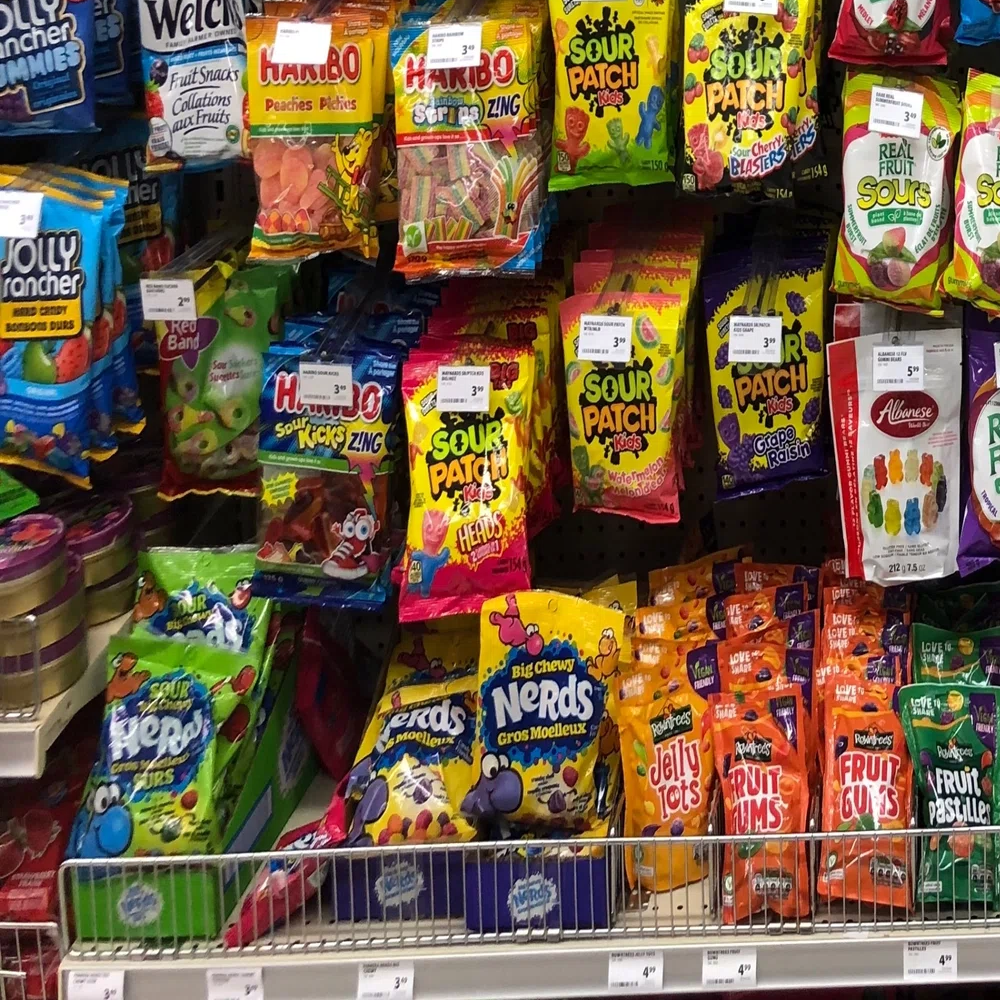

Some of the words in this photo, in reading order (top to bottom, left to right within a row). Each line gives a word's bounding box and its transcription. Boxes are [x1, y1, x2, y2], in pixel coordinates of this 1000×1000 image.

[569, 33, 634, 64] SOUR
[710, 49, 781, 79] SOUR
[170, 69, 199, 91] Fruit
[199, 66, 239, 82] Snacks
[568, 61, 638, 95] PATCH
[172, 94, 232, 117] Collations
[597, 91, 624, 106] Kids
[707, 79, 785, 115] PATCH
[172, 115, 195, 134] aux
[196, 109, 231, 127] Fruits
[736, 112, 766, 129] Kids
[751, 136, 784, 155] Cherry
[879, 142, 914, 160] REAL
[729, 147, 786, 178] BLASTERS
[878, 160, 914, 177] FRUIT
[857, 176, 932, 210] Sours
[4, 235, 77, 275] JOLLY
[3, 272, 80, 297] rancher
[13, 306, 37, 317] HARD
[5, 322, 47, 332] BONBONS
[49, 320, 75, 331] DURS
[171, 320, 196, 334] Red
[168, 332, 199, 350] Band
[584, 370, 650, 403] SOUR
[734, 363, 806, 406] PATCH
[766, 396, 793, 415] Kids
[876, 398, 934, 424] Albanese
[275, 416, 308, 438] Sour
[582, 402, 656, 437] PATCH
[431, 419, 503, 461] SOUR
[613, 433, 642, 451] Kids
[752, 427, 796, 457] Grape
[768, 440, 811, 468] Raisin
[429, 447, 509, 496] PATCH
[458, 511, 503, 552] HEADS
[889, 563, 901, 573] 212
[907, 563, 918, 572] 7.5
[512, 662, 534, 680] Big
[535, 658, 575, 675] Chewy
[497, 730, 529, 746] Gros
[531, 722, 587, 740] Moelleux
[650, 740, 702, 790] Jelly
